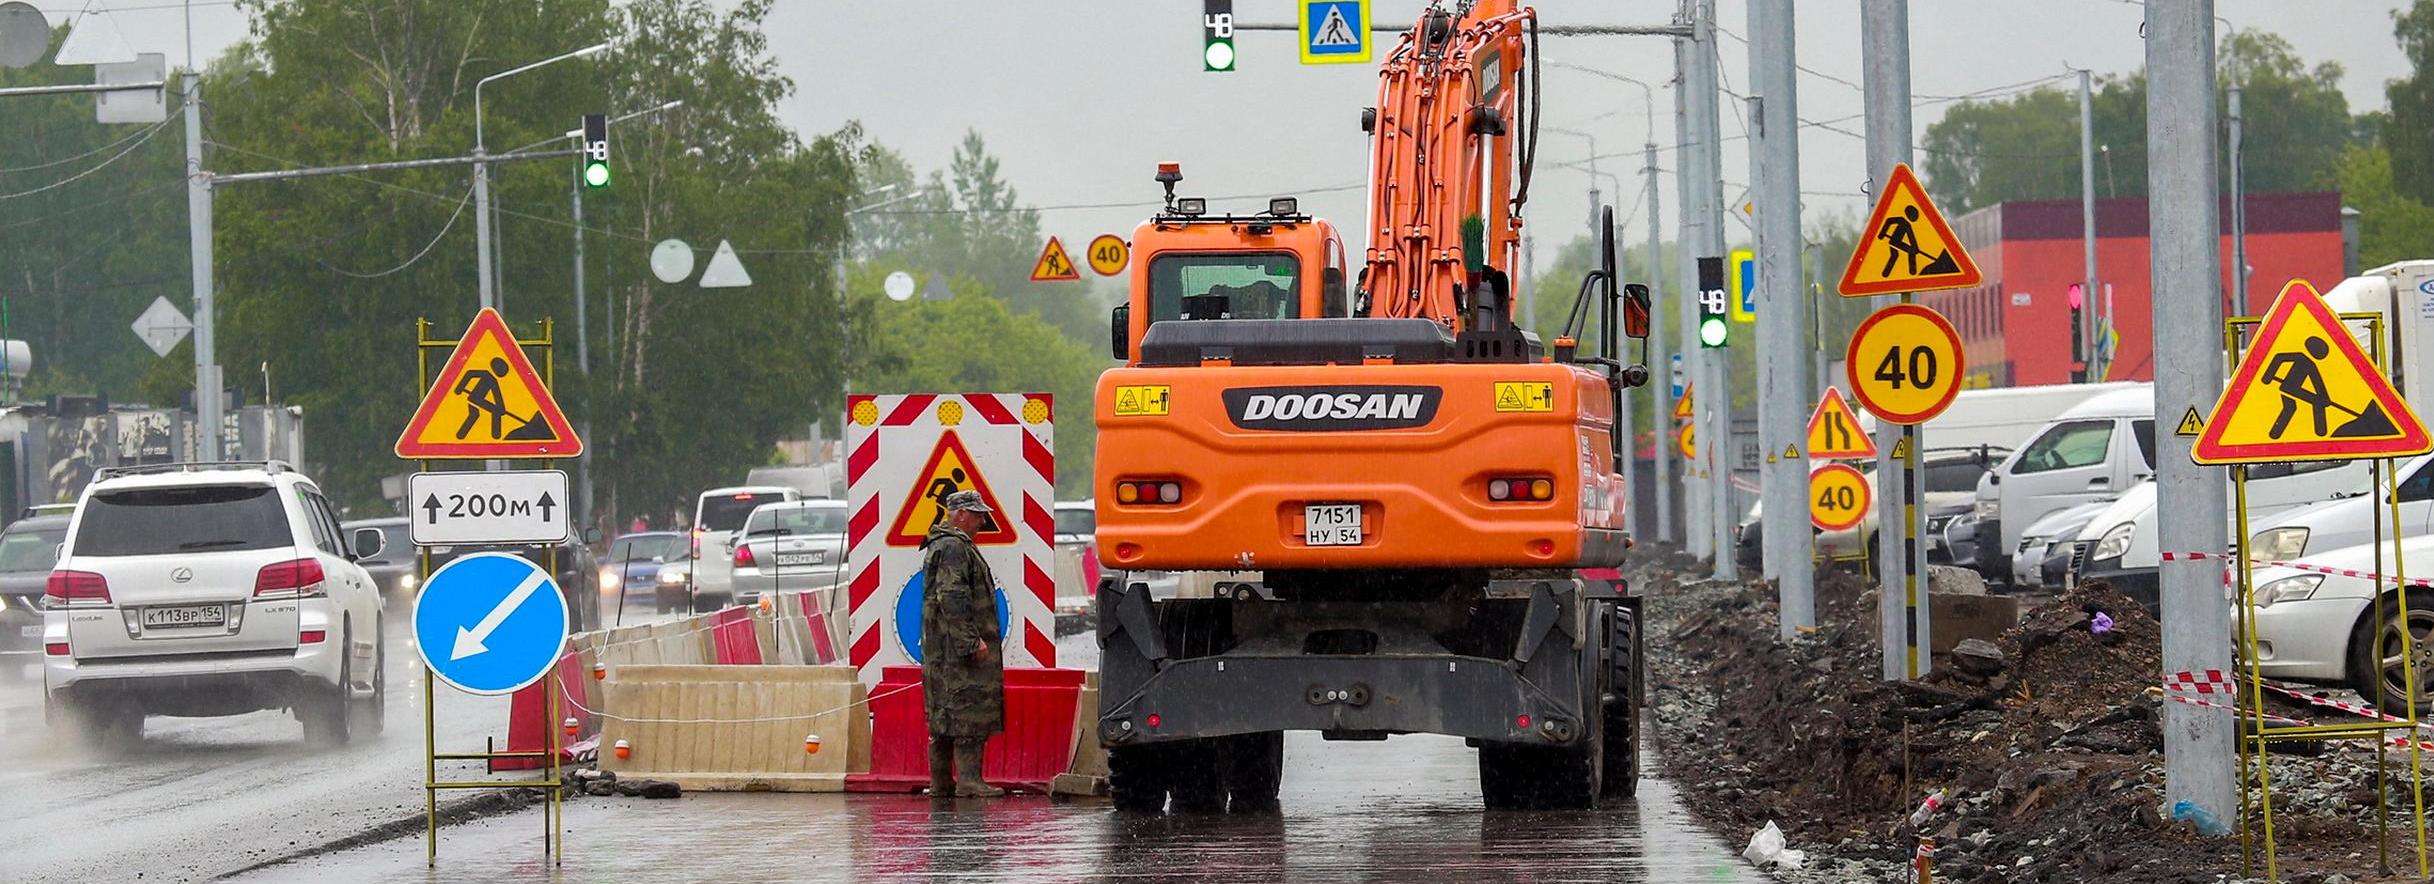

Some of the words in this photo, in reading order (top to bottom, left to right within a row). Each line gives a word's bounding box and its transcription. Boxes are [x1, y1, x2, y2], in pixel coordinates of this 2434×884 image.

[1205, 13, 1232, 38] 48
[586, 141, 606, 160] 48
[1096, 246, 1120, 263] 40
[1699, 289, 1725, 314] 48
[1874, 345, 1937, 390] 40
[1242, 393, 1424, 421] DOOSAN
[1817, 486, 1855, 511] 40
[1312, 507, 1354, 525] 7151
[1340, 529, 1357, 542] 54
[201, 606, 220, 617] 154
